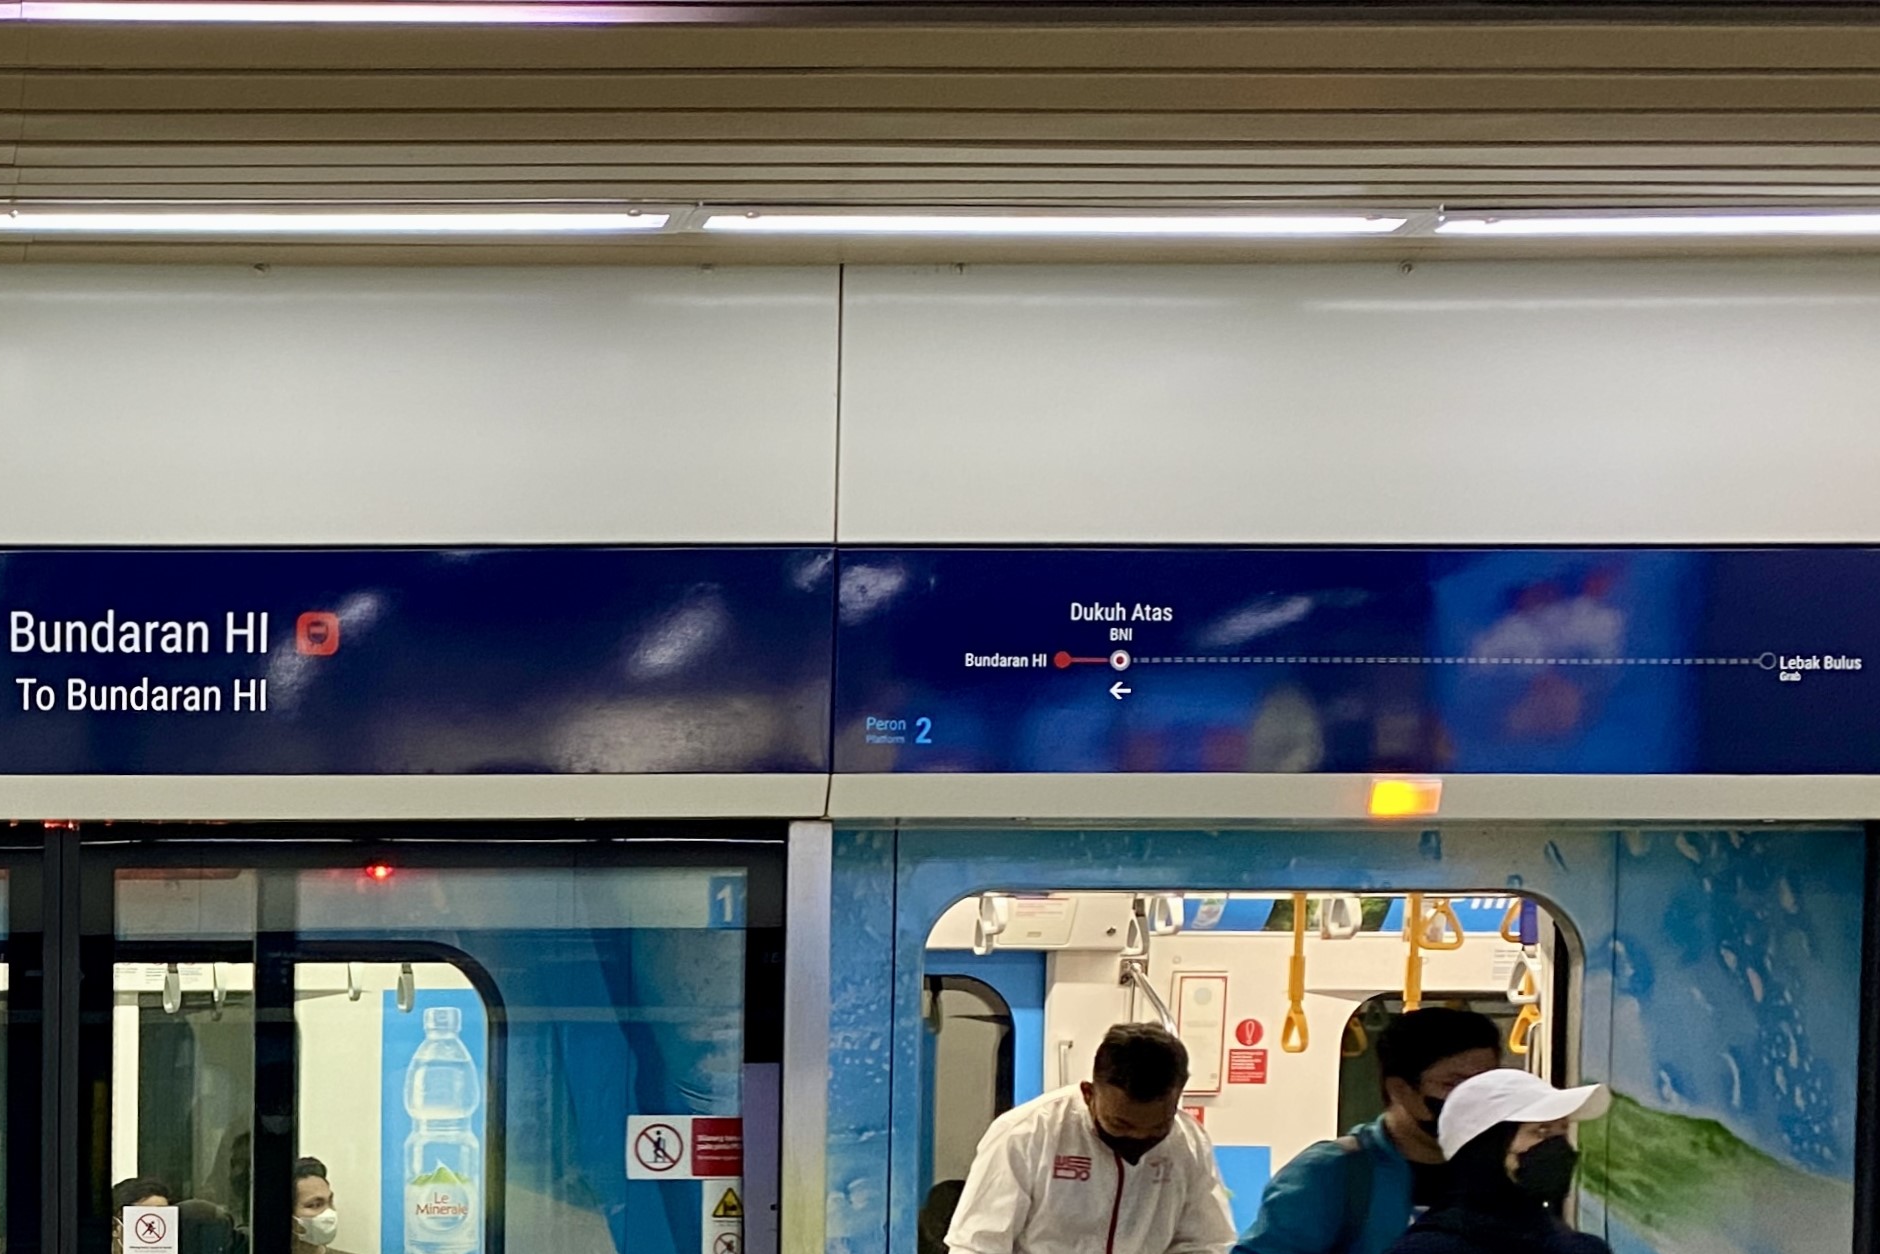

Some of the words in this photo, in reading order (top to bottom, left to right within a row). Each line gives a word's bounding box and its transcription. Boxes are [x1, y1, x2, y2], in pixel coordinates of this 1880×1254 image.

[1070, 602, 1126, 622] Dukuh
[1131, 603, 1173, 622] Atas
[10, 610, 209, 654] Bundaran
[226, 612, 269, 654] HI
[1110, 628, 1132, 641] BNI
[964, 653, 1029, 668] Bundaran
[1033, 654, 1047, 668] HI
[1779, 655, 1820, 670] Lebak
[1823, 655, 1862, 670] Bulus
[1779, 671, 1801, 681] Grab
[16, 678, 55, 711] To
[67, 677, 221, 712] Bundaran
[233, 679, 267, 712] HI
[866, 717, 906, 731] Peron
[915, 716, 932, 744] 2
[433, 1192, 450, 1205] Le
[415, 1203, 469, 1216] Minerale
